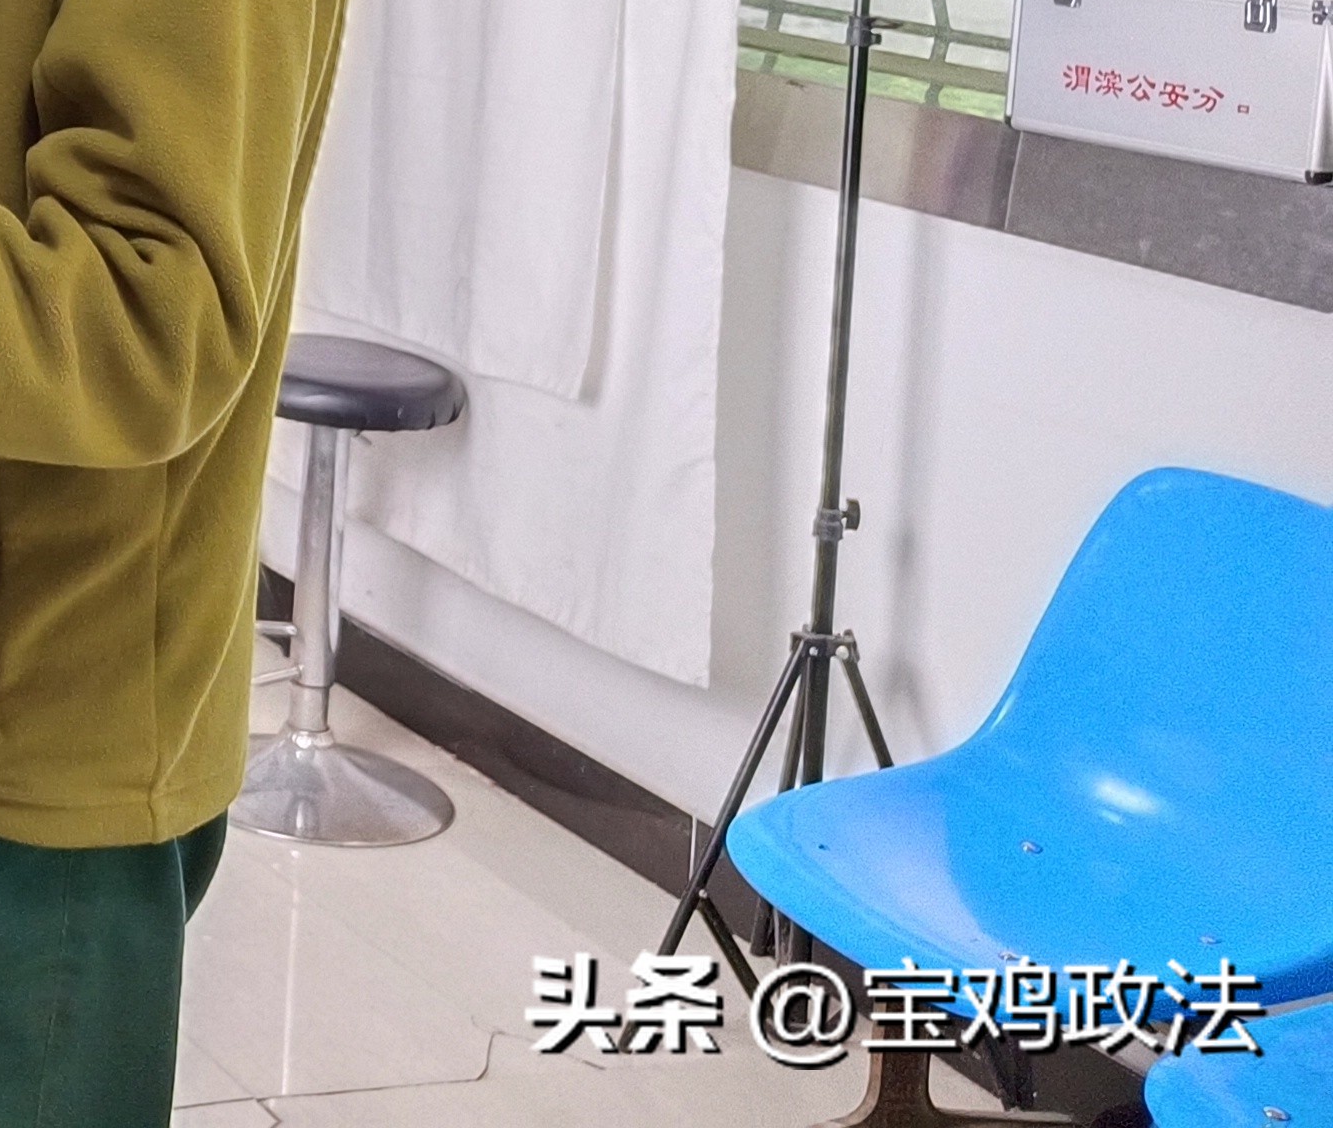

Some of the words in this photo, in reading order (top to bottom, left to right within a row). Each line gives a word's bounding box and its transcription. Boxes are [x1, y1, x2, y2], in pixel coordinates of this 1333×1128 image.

[1062, 63, 1252, 115] 渭滨公安分
